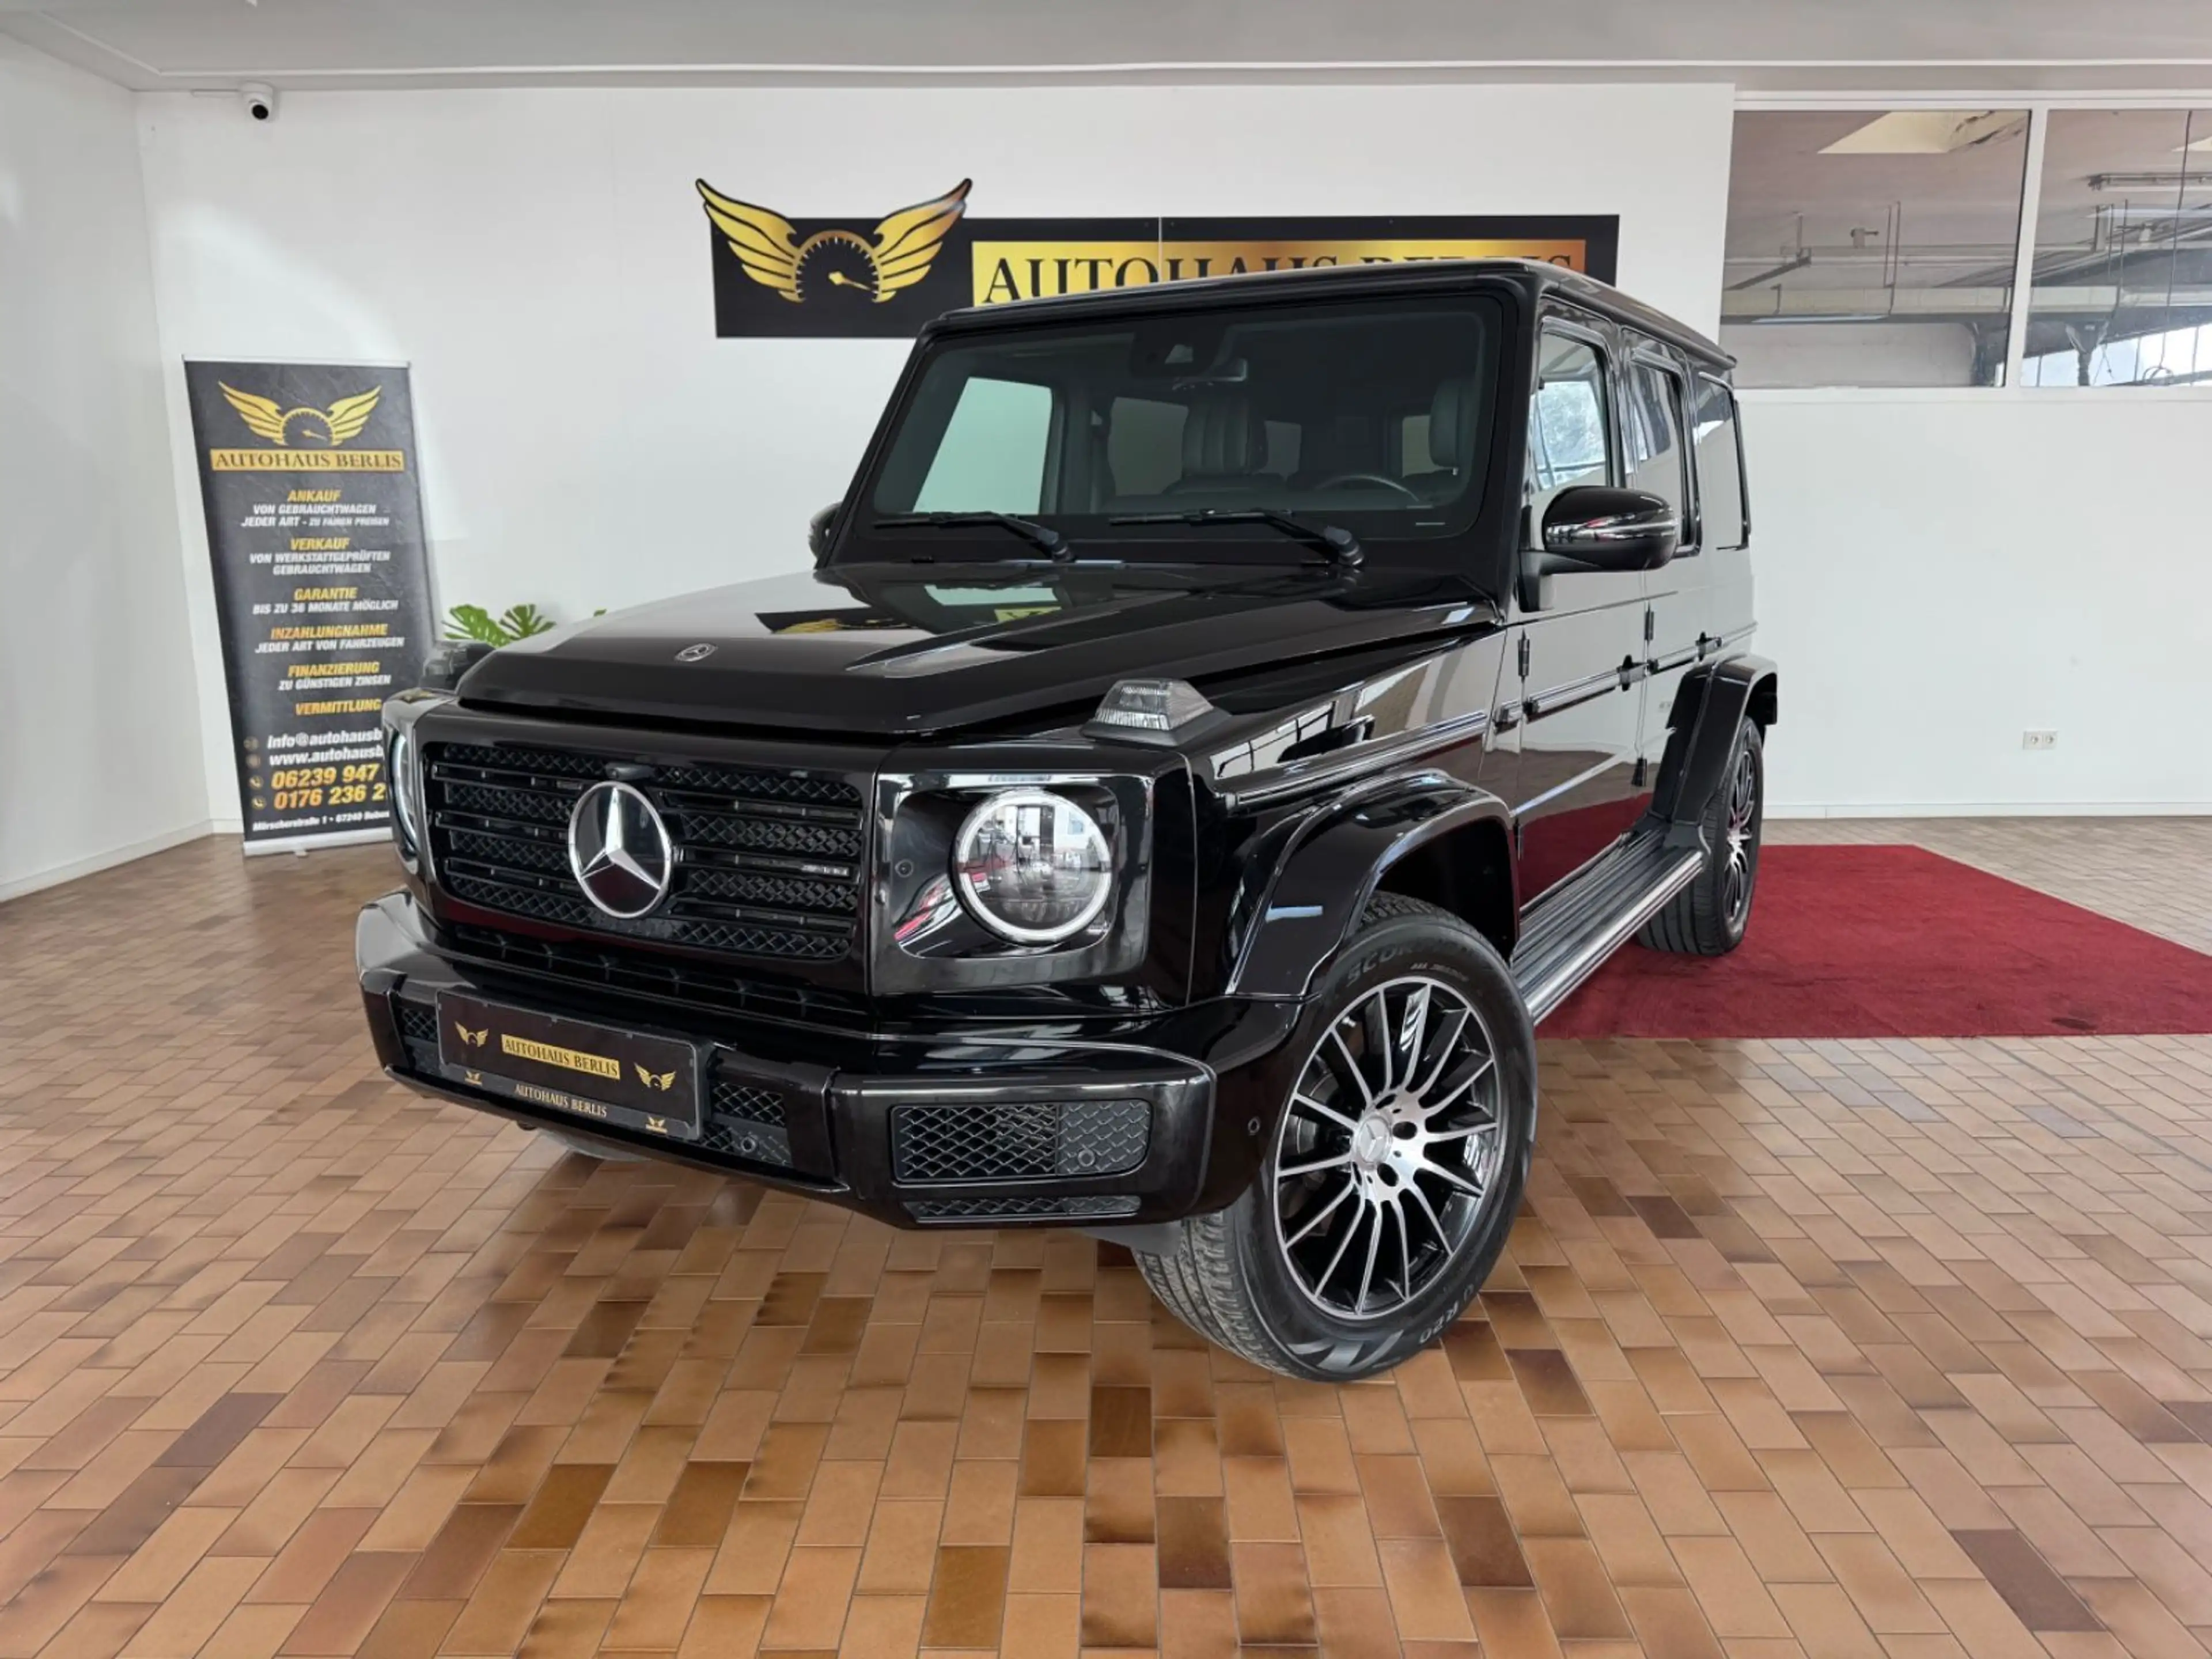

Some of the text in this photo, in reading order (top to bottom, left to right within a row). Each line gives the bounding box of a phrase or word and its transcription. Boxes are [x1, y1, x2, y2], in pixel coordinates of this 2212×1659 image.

[982, 256, 1338, 304] AUTO
[215, 452, 401, 468] AUTOHAUS BERLIS
[287, 490, 342, 502] ANKAUF
[253, 504, 377, 514] VON GEBRAUCHTWAGEN
[241, 517, 275, 527] JEDER
[278, 517, 300, 527] ART
[290, 537, 350, 550] VERKAUF
[249, 553, 272, 563] VON
[273, 563, 372, 575] GEBRAUCHTWAGEN
[294, 588, 358, 601] GARANTIE
[252, 604, 271, 615] BIS
[274, 604, 287, 613] ZU
[308, 601, 350, 612] MONATE
[353, 599, 399, 611] MÖGLICH
[271, 624, 389, 640] INZAHLUNGNAHME
[255, 637, 404, 653] JEDER ART VON FAHRZEUGEN
[289, 662, 380, 677] FINANZIERUNG
[278, 675, 392, 691] ZU GÜNSTIGEN ZINSEN
[296, 699, 382, 715] VERMITTLUNG
[271, 763, 380, 789] 06239 947
[274, 783, 387, 809] 0176 236 2
[505, 1039, 618, 1076] AUTOHAUS BERLIS
[514, 1084, 607, 1118] AUTOHAUS BERLIS
